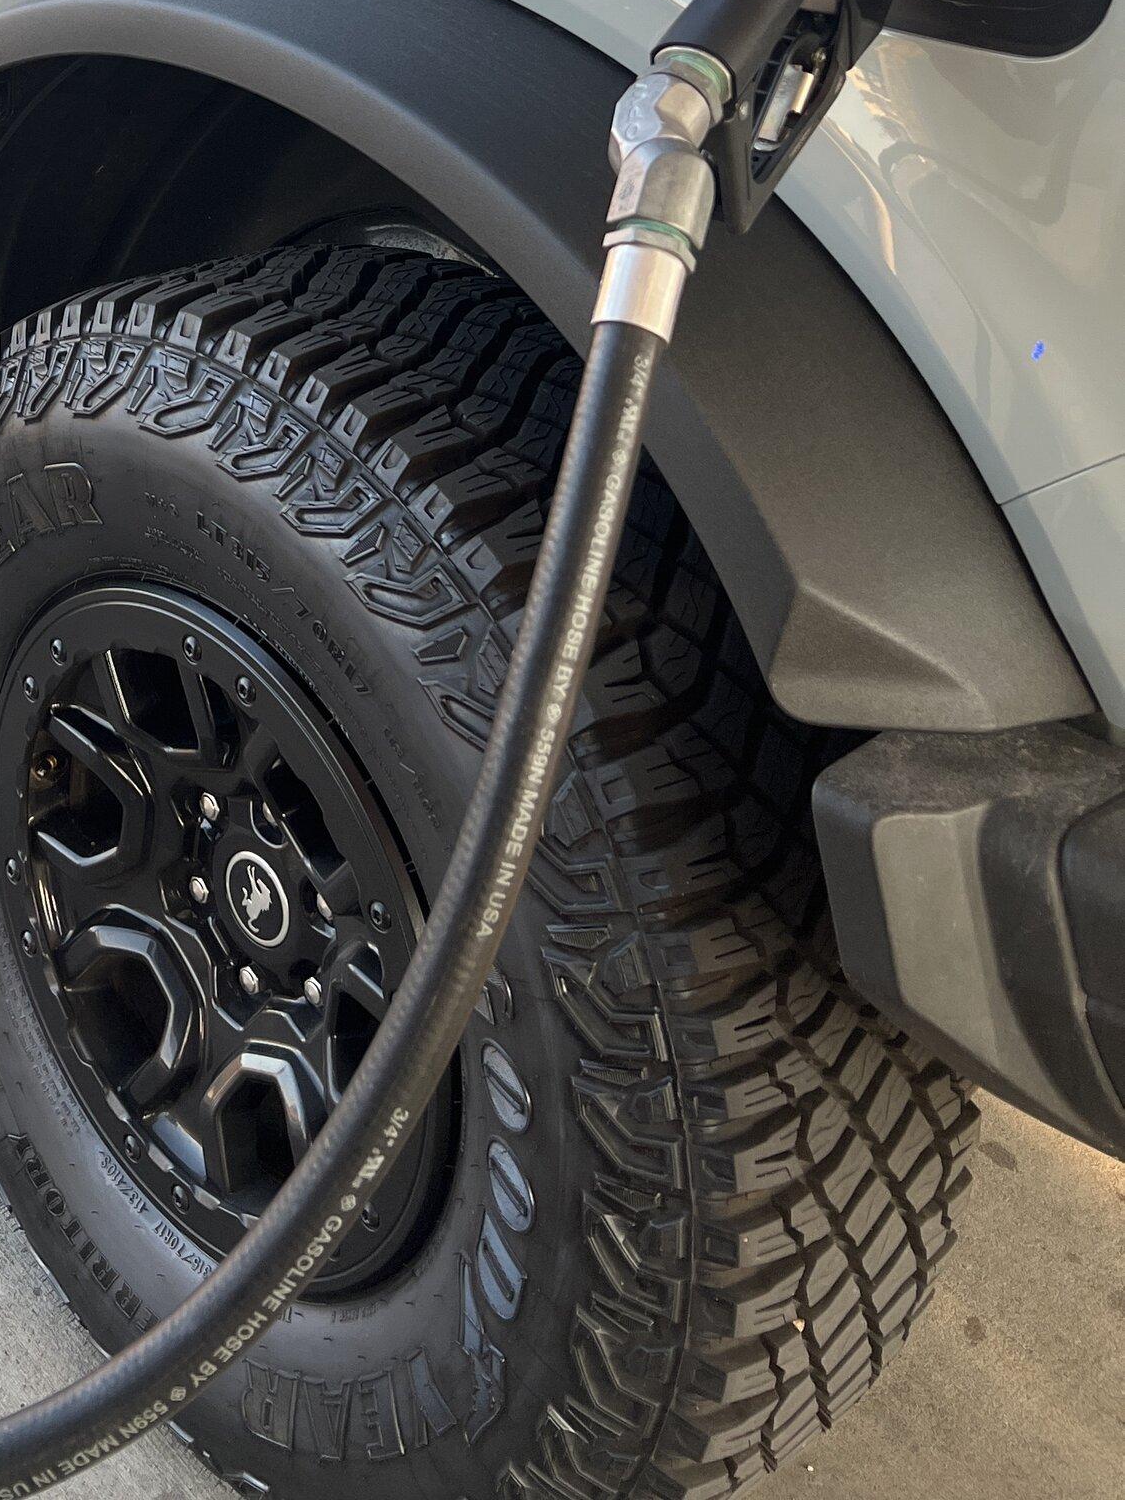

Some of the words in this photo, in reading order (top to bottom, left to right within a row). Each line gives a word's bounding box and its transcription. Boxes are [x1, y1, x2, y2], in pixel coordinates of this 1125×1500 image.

[581, 473, 622, 591] GASOLINE
[564, 593, 592, 661] HOSE
[552, 664, 574, 699] BY
[527, 727, 556, 785] 559N
[505, 789, 540, 857] MADE
[497, 862, 517, 888] IN
[476, 891, 506, 937] USA
[5, 1134, 161, 1332] ERRITORY
[262, 1214, 342, 1312] GASOLINE
[213, 1310, 268, 1363] HOSE
[190, 1360, 218, 1388] BY
[119, 1400, 169, 1439] 559N
[32, 1468, 58, 1488] IN
[58, 1434, 120, 1475] MADE
